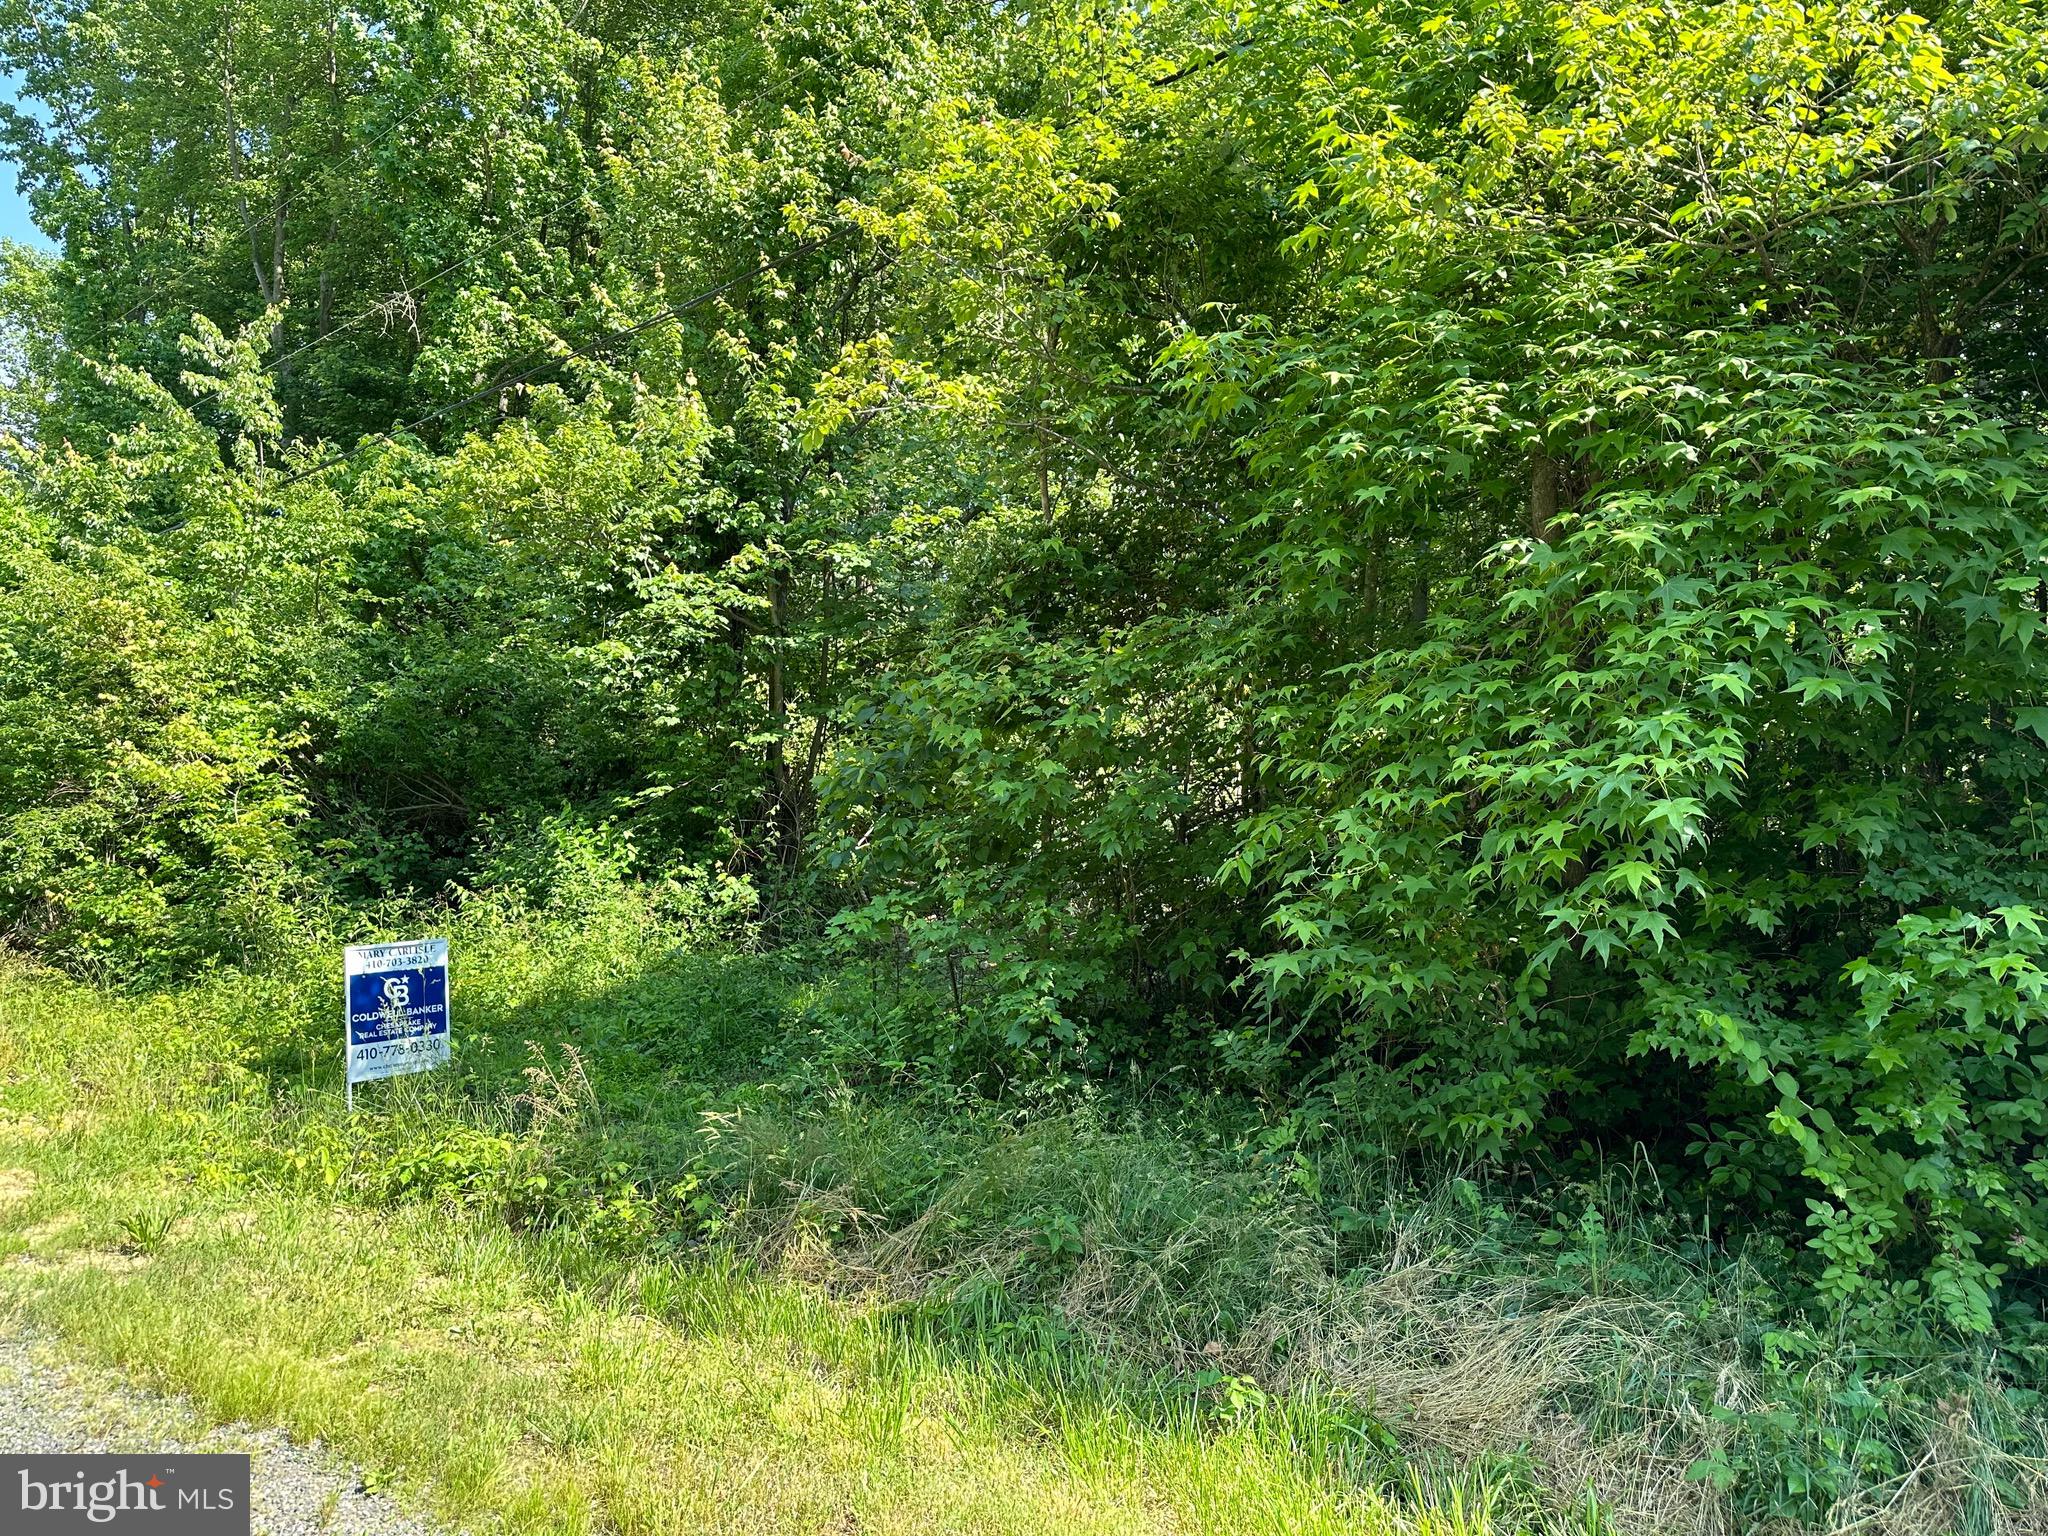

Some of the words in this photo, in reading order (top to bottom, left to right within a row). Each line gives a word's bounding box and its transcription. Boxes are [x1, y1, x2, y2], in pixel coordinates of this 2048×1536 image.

[358, 949, 385, 960] MARY
[388, 945, 436, 957] CARLISLE
[366, 955, 429, 968] 410-703-3820
[407, 1004, 443, 1016] BANKER
[376, 1018, 421, 1030] CHESAPAKE
[359, 1031, 378, 1040] REAL
[379, 1027, 402, 1037] ESTATE
[356, 1038, 440, 1060] 410-778-0330
